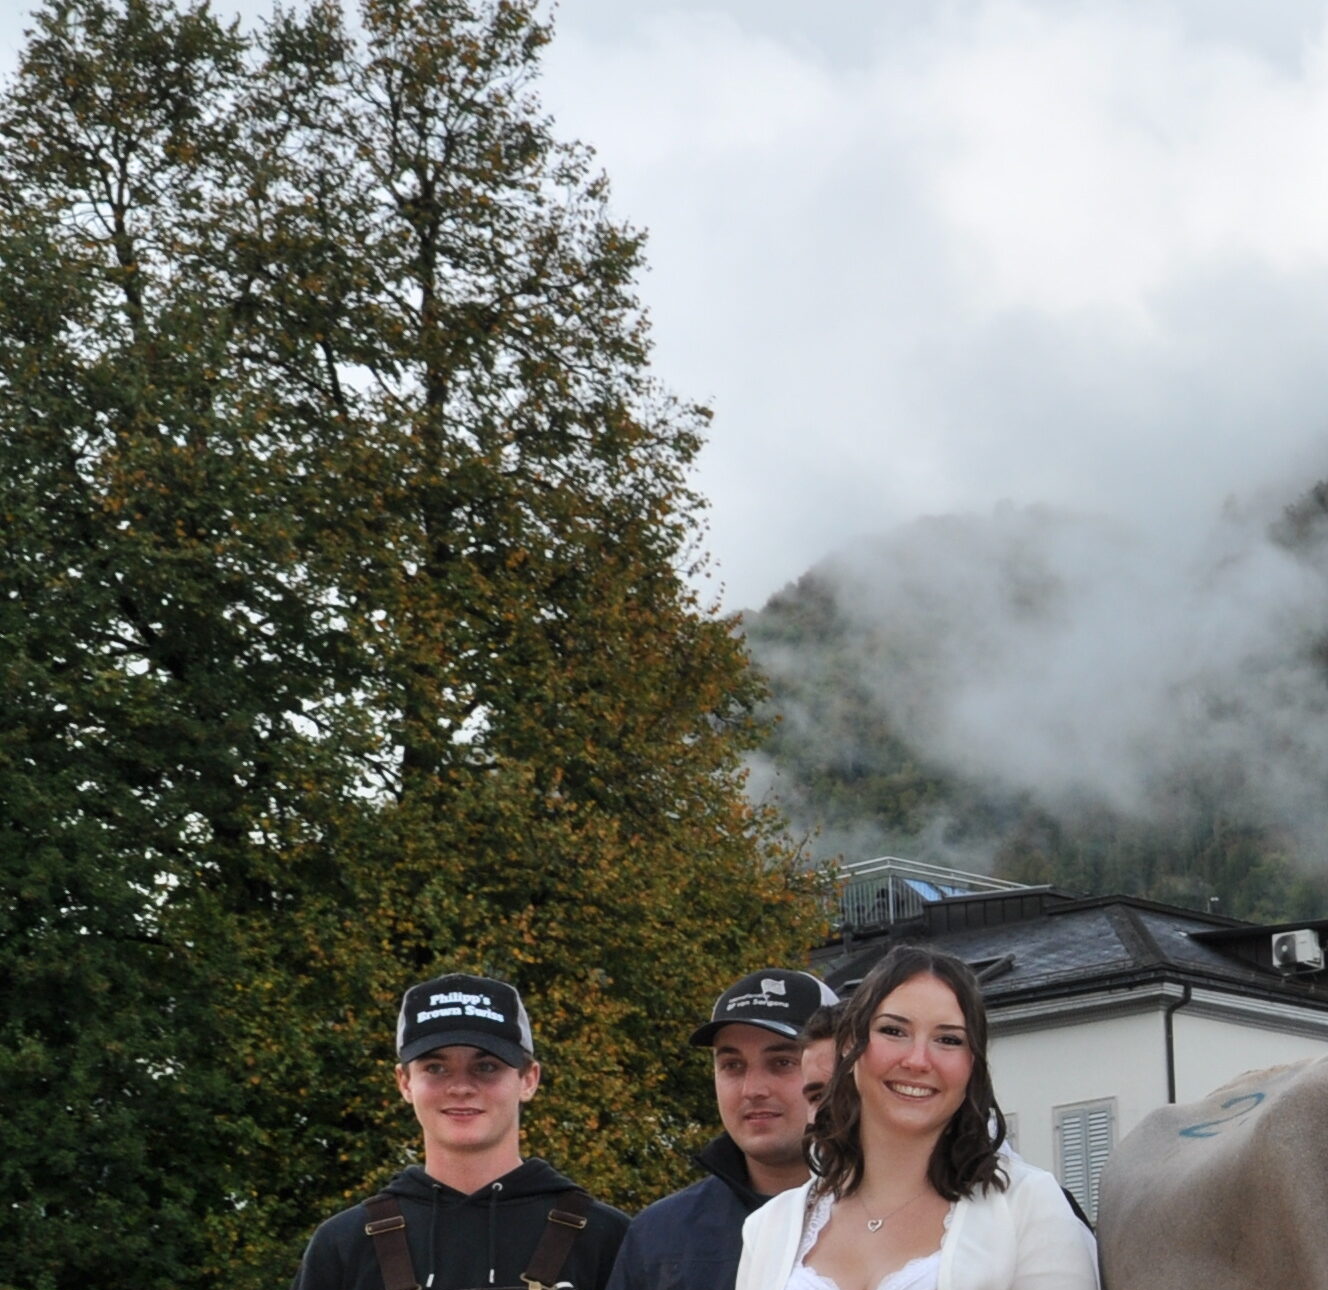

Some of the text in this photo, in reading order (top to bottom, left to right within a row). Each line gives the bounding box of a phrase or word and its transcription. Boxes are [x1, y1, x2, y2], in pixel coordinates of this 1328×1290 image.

[429, 992, 491, 1006] Philipp's
[417, 1005, 504, 1023] Brown Swiss
